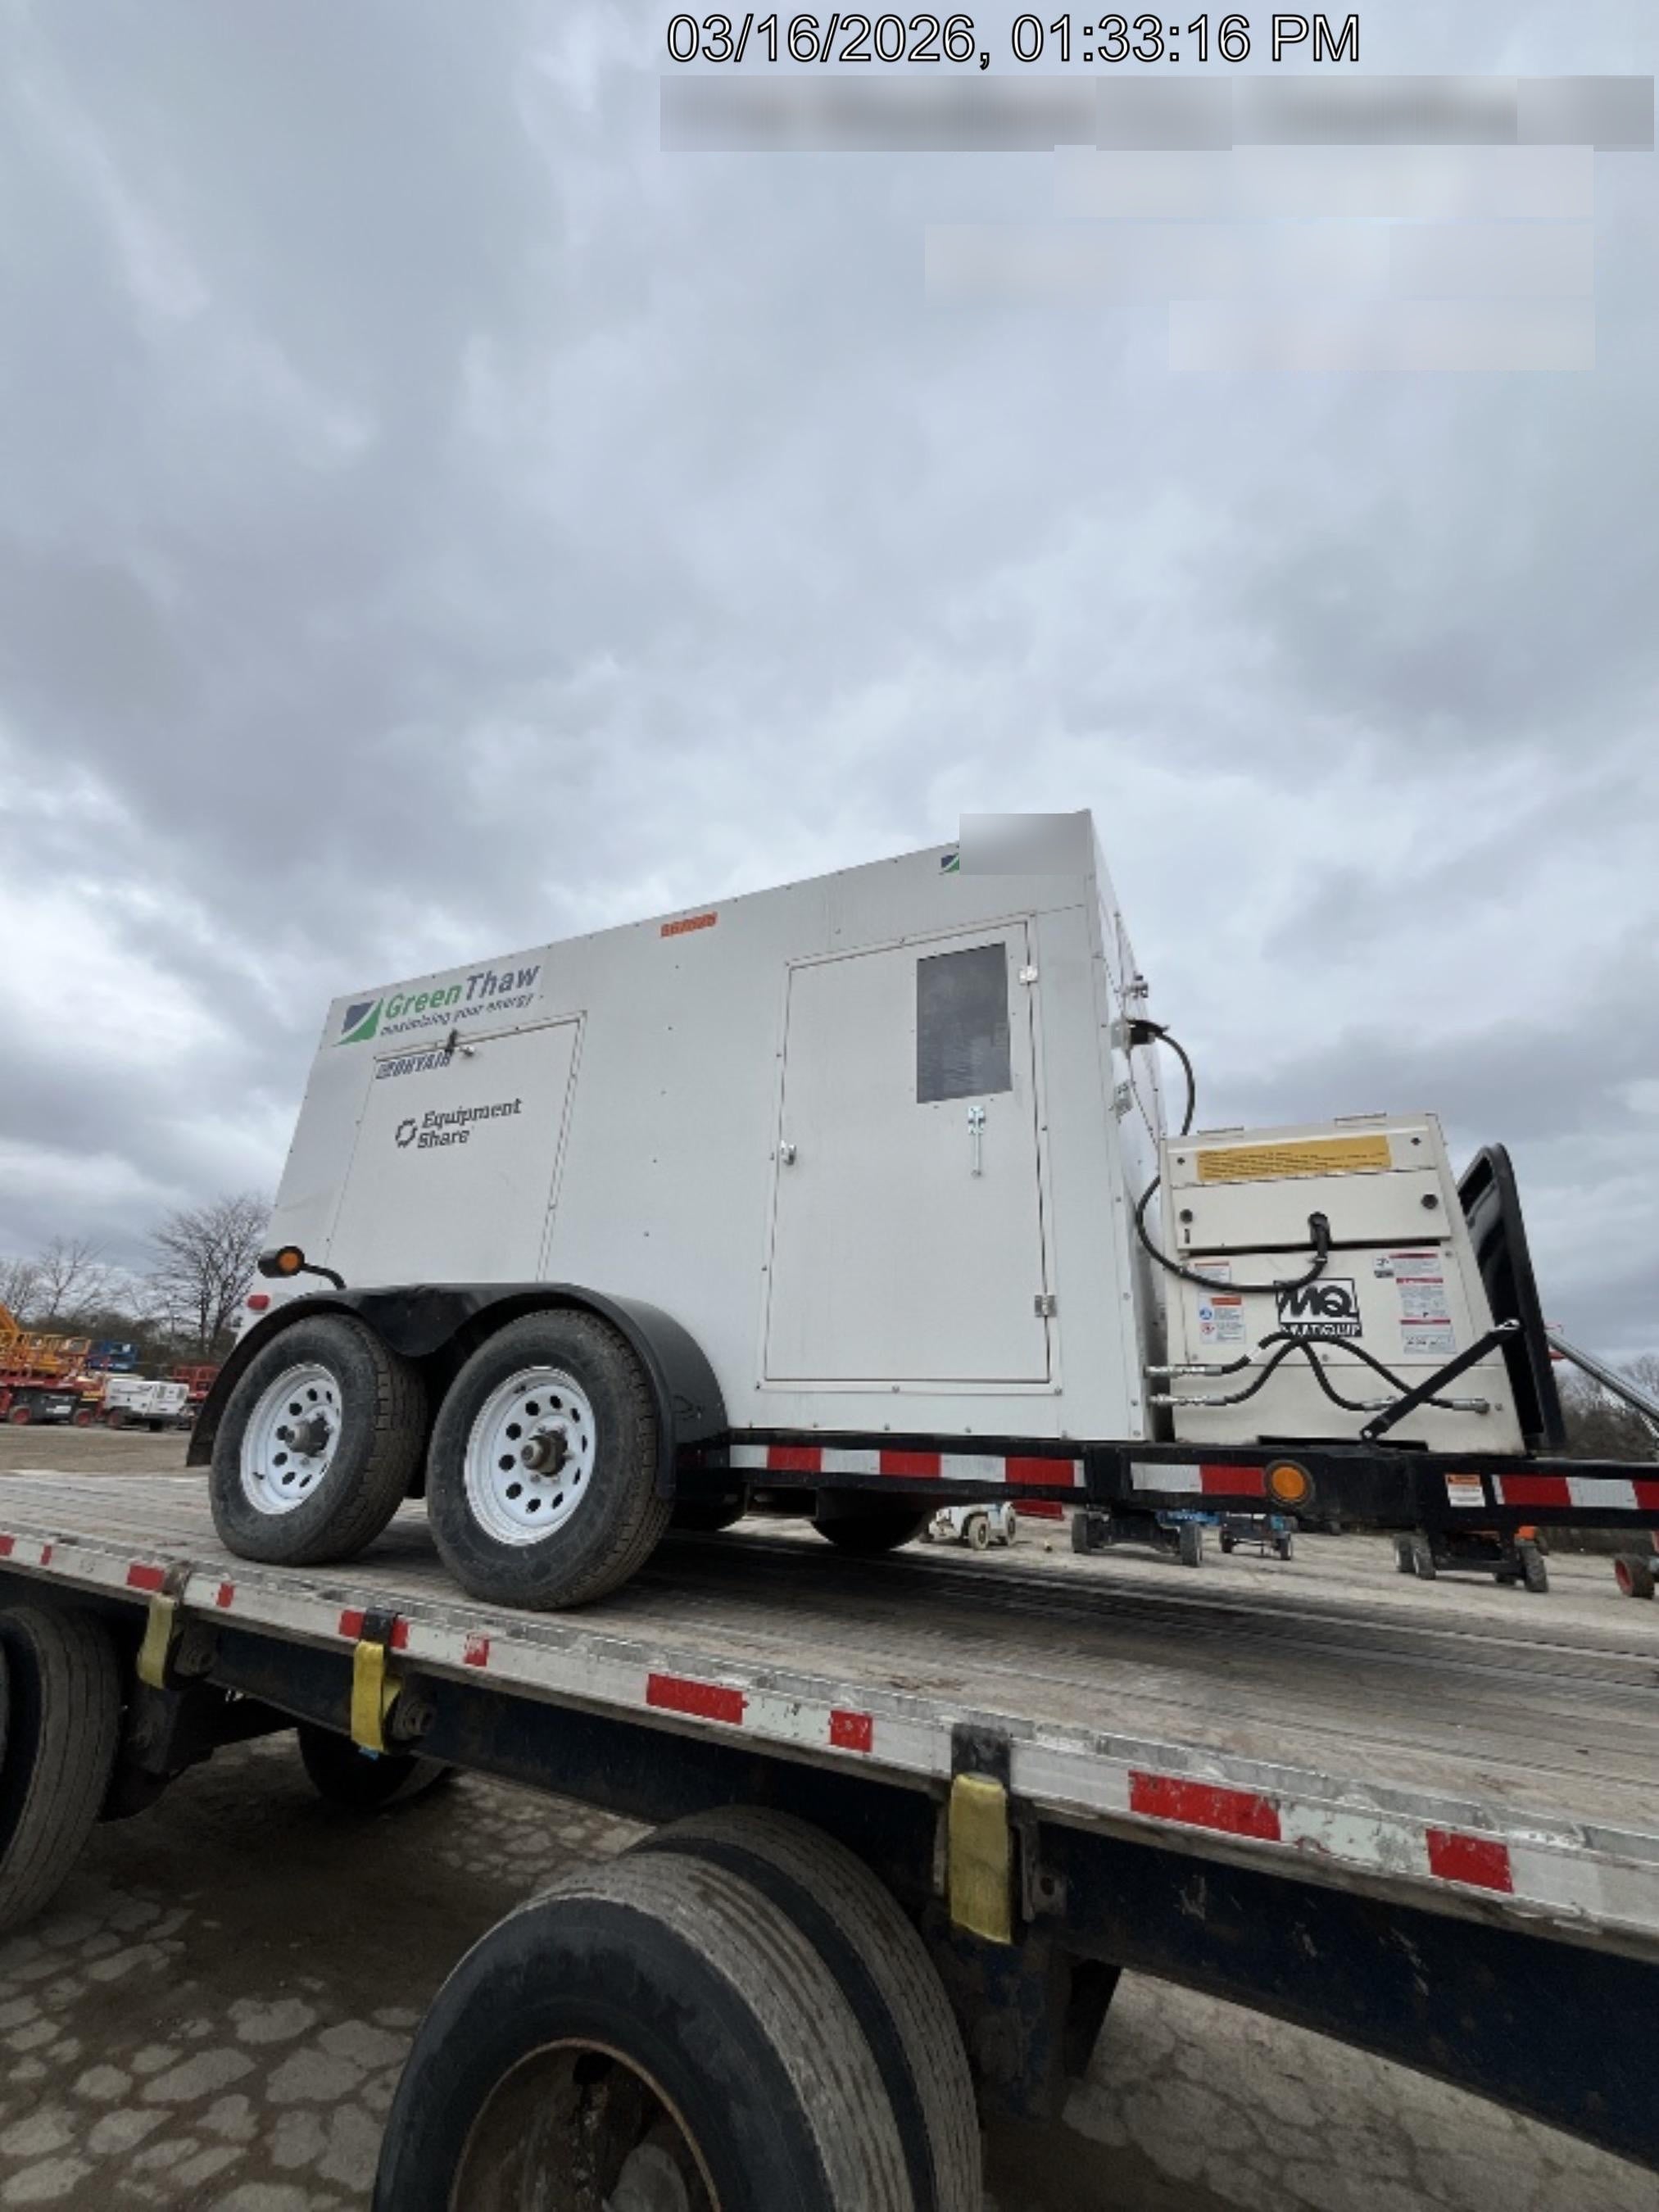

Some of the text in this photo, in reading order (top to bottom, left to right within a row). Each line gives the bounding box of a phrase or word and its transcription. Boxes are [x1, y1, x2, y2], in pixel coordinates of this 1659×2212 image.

[421, 1098, 523, 1130] Equipment
[417, 1130, 470, 1149] Share
[1278, 1284, 1358, 1318] MQ
